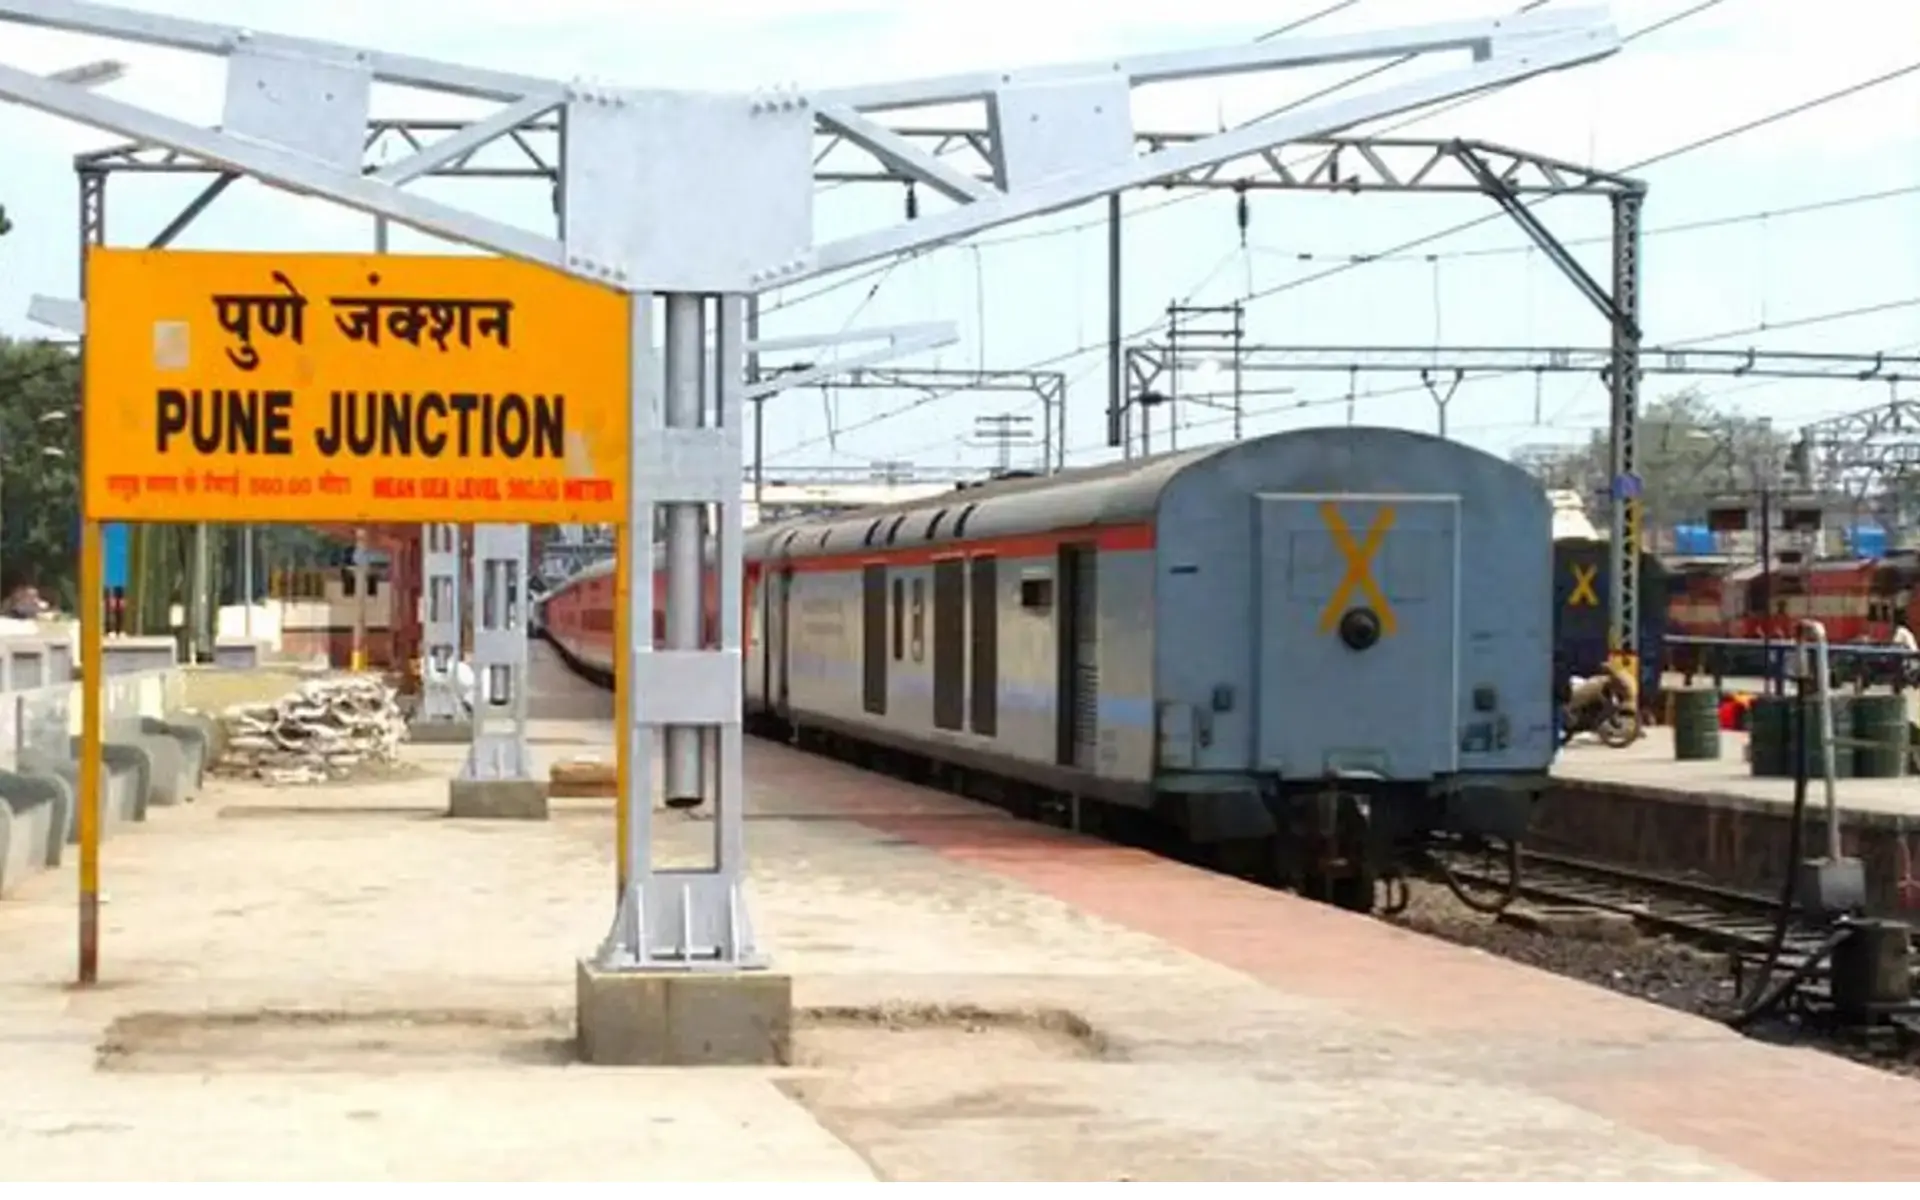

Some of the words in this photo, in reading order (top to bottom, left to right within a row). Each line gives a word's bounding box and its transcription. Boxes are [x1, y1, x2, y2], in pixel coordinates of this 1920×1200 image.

[213, 272, 308, 371] पुणे
[330, 275, 513, 351] जंक्शन
[156, 389, 293, 455] PUNE
[315, 392, 564, 459] JUNCTION
[455, 477, 502, 504] LEVEL
